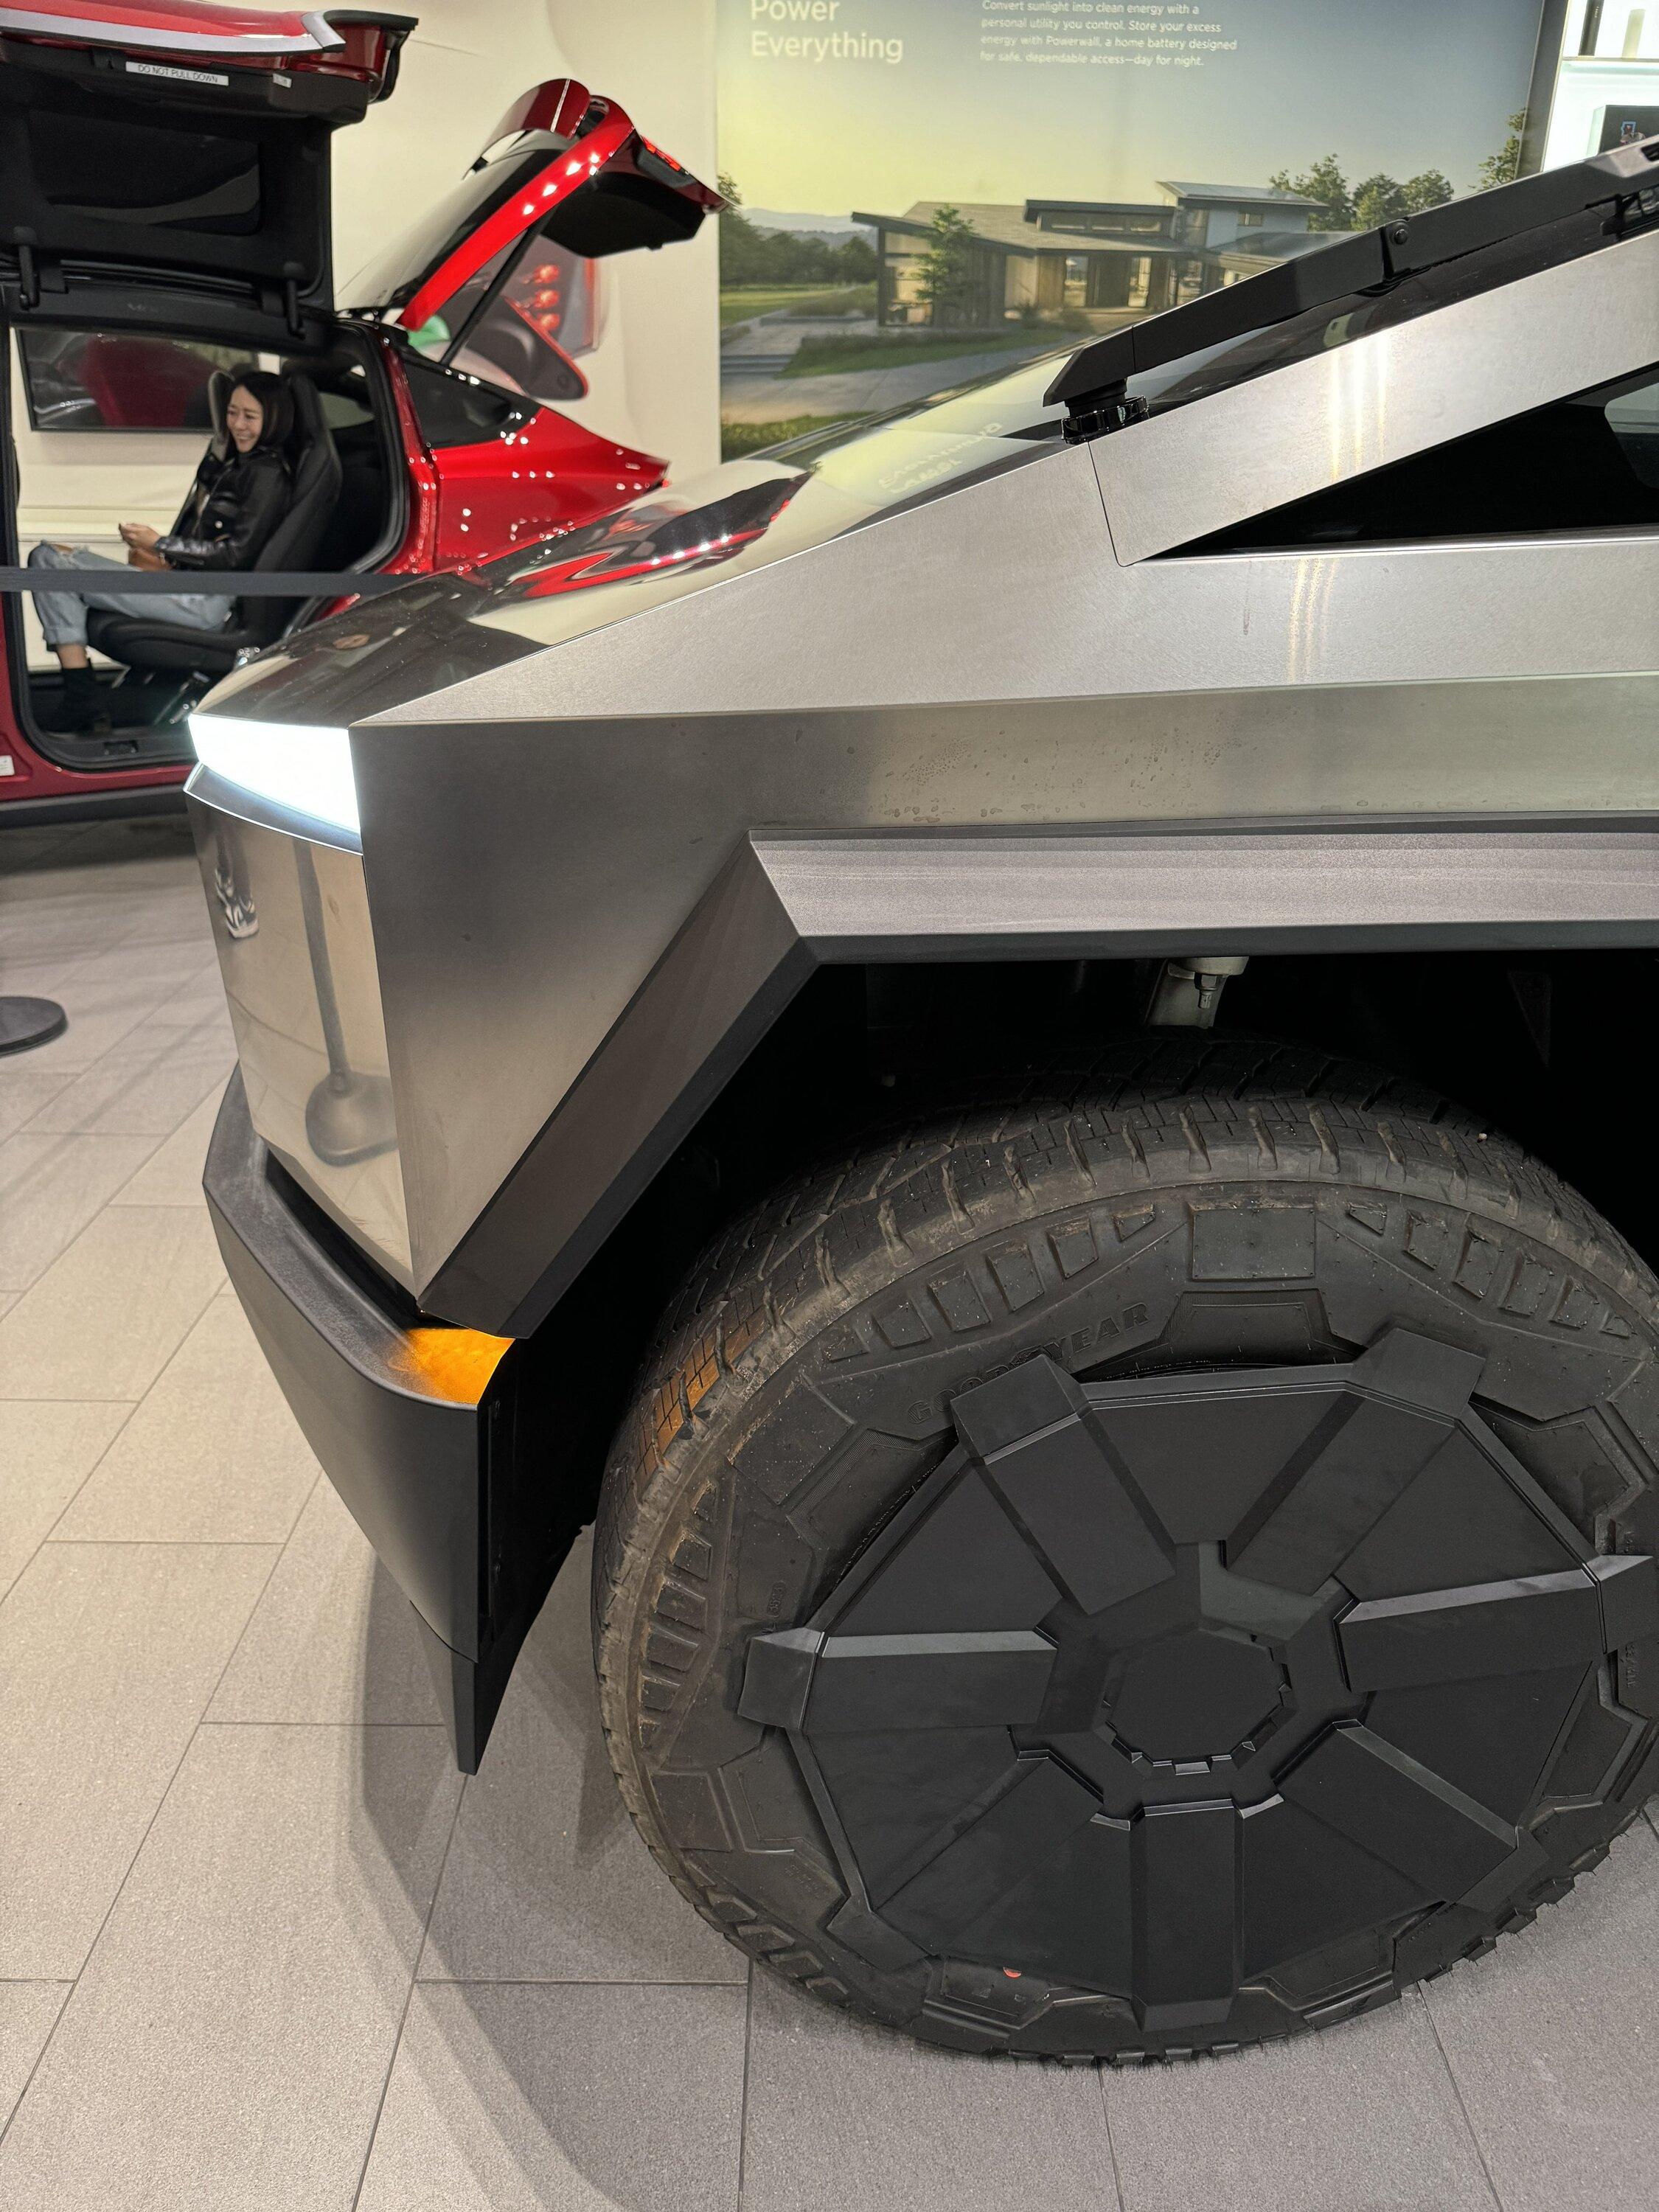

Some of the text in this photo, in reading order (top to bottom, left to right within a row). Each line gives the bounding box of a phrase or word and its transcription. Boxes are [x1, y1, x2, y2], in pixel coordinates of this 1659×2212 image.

[751, 0, 840, 21] Power
[982, 1, 1024, 10] Convert
[1027, 1, 1069, 13] sunlight
[1072, 2, 1093, 12] into
[1096, 2, 1124, 13] clean
[1127, 4, 1164, 15] energy
[1167, 4, 1189, 14] with
[981, 18, 1221, 32] personal utility you control. Store your excess
[751, 30, 903, 63] Everything
[981, 36, 1017, 46] energy
[1020, 36, 1043, 45] with
[1115, 38, 1144, 47] home
[1147, 38, 1186, 49] battery
[1189, 39, 1237, 51] designed
[980, 51, 995, 61] for
[1025, 53, 1088, 63] dependable
[1156, 55, 1171, 65] for
[1174, 56, 1204, 67] night.
[138, 64, 218, 83] DO NOT PULL DOWN
